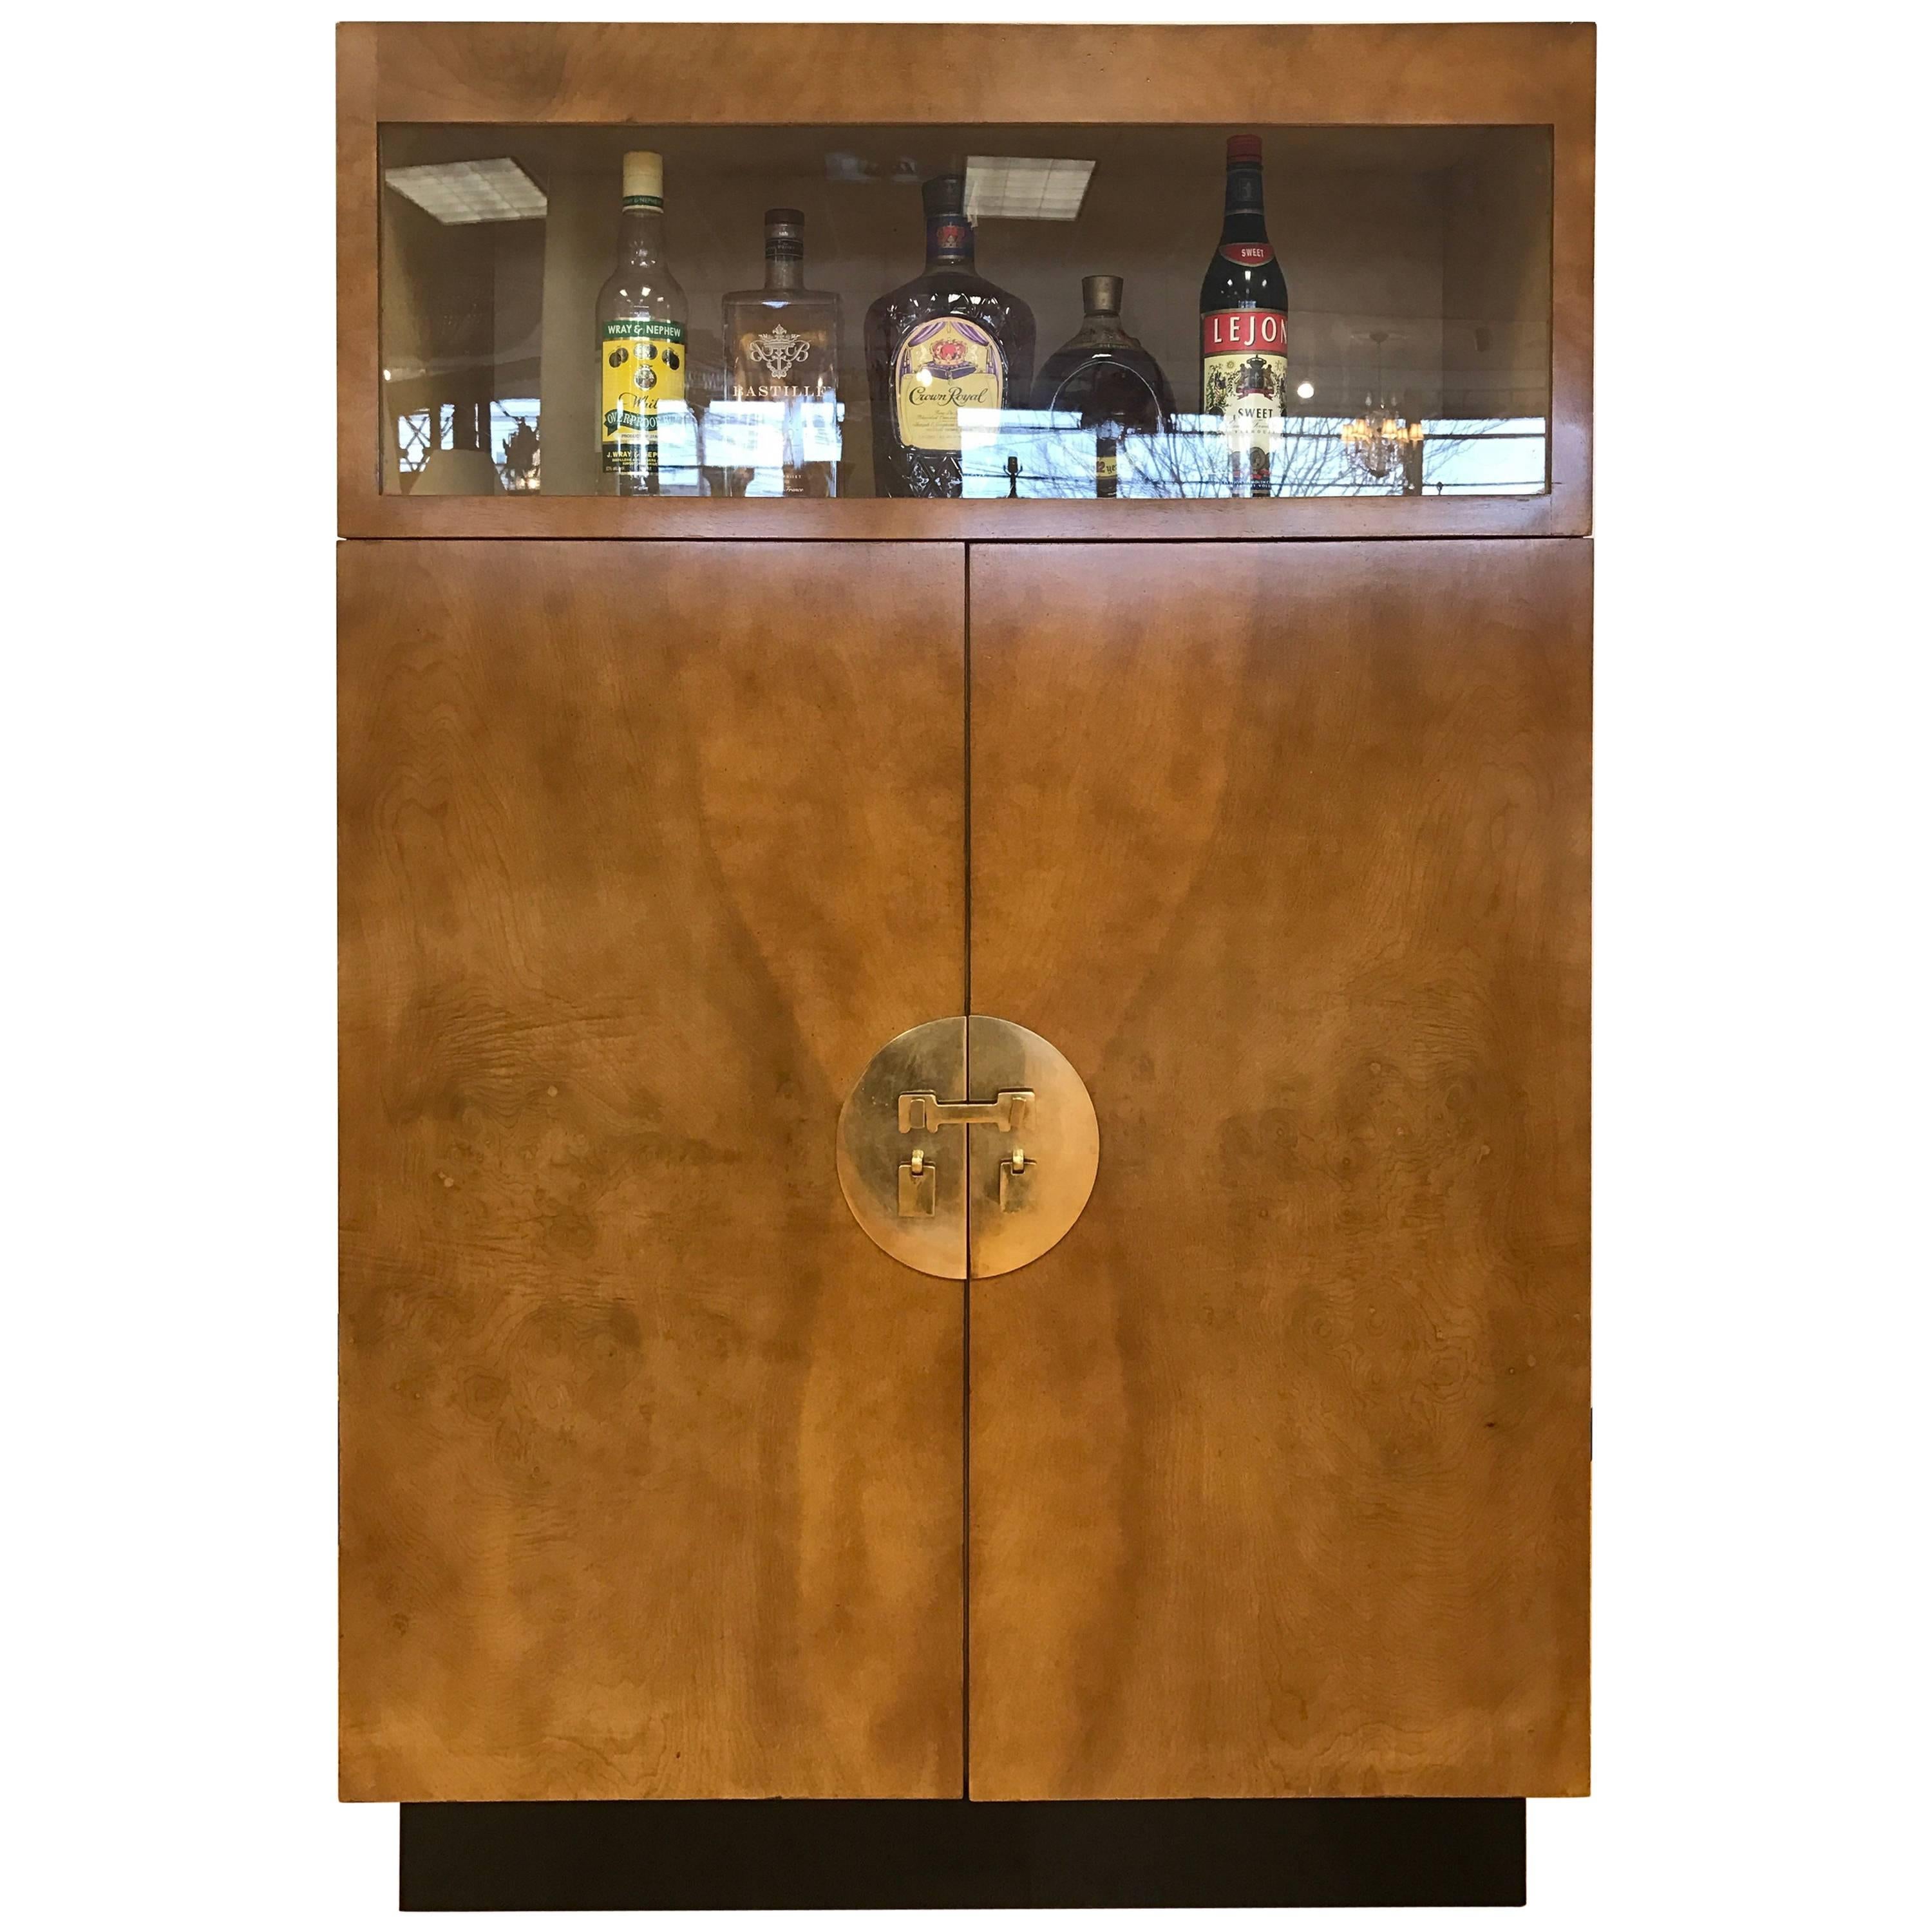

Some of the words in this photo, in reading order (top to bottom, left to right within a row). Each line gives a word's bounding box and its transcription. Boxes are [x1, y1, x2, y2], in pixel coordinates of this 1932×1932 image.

[1241, 248, 1264, 258] SWEET
[608, 325, 632, 334] WRAY
[634, 325, 643, 334] &
[646, 325, 681, 337] NEPHEW
[1214, 316, 1287, 346] LEJON
[733, 386, 826, 397] BASTILLE
[909, 386, 947, 406] Crown
[938, 386, 988, 407] Royal
[1238, 408, 1273, 419] SWEET
